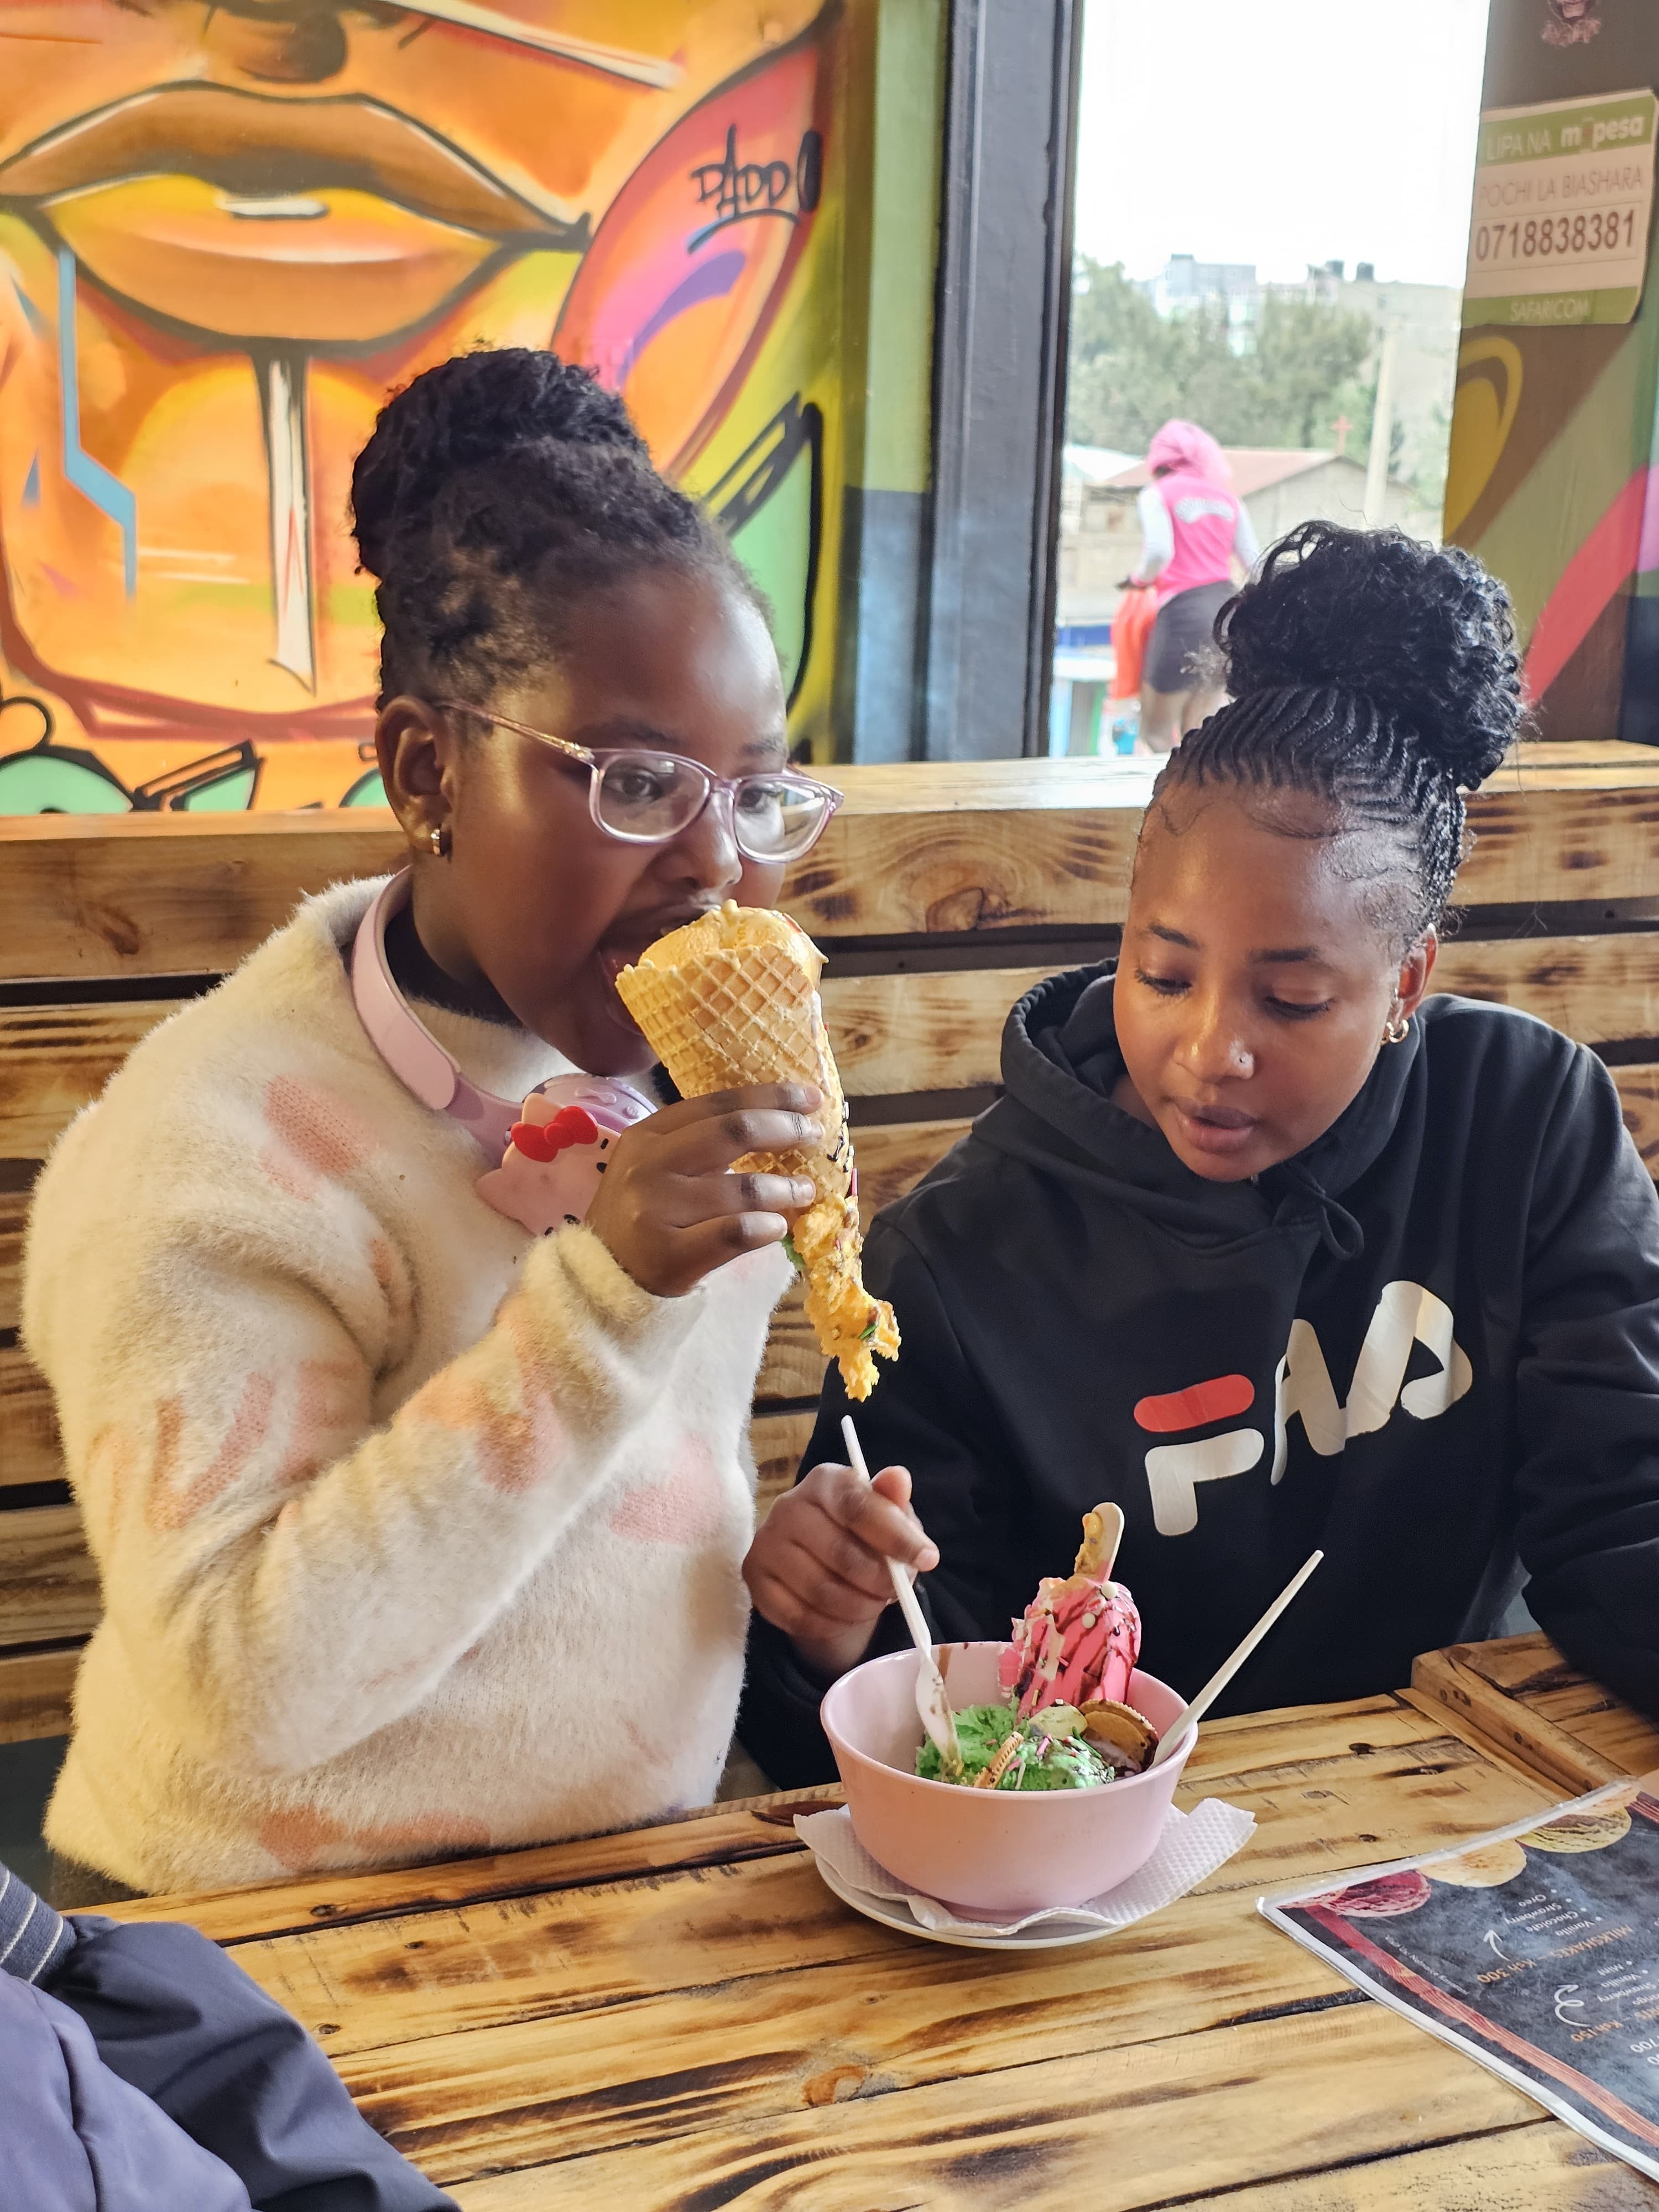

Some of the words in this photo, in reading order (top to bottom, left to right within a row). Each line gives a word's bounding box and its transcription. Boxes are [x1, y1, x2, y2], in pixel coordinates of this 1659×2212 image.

[1486, 133, 1523, 161] LIPA
[1527, 129, 1552, 154] NA
[1478, 179, 1531, 207] POCHI
[1537, 177, 1556, 201] LA
[1562, 165, 1644, 198] BIASHARA
[1475, 209, 1634, 262] 0718838381
[1510, 298, 1589, 322] SAFARICOM
[1518, 1894, 1547, 1907] Oreo
[1504, 1902, 1562, 1924] Strawberry
[1525, 1911, 1579, 1932] Chocolate
[1554, 1920, 1595, 1936] Vanilla
[1550, 1924, 1633, 1959] MILKSHAKES
[1477, 1968, 1511, 1984] 300
[1507, 1958, 1537, 1973] Ksh
[1597, 1963, 1624, 1976] Mint
[1601, 1973, 1642, 1988] Vanilla
